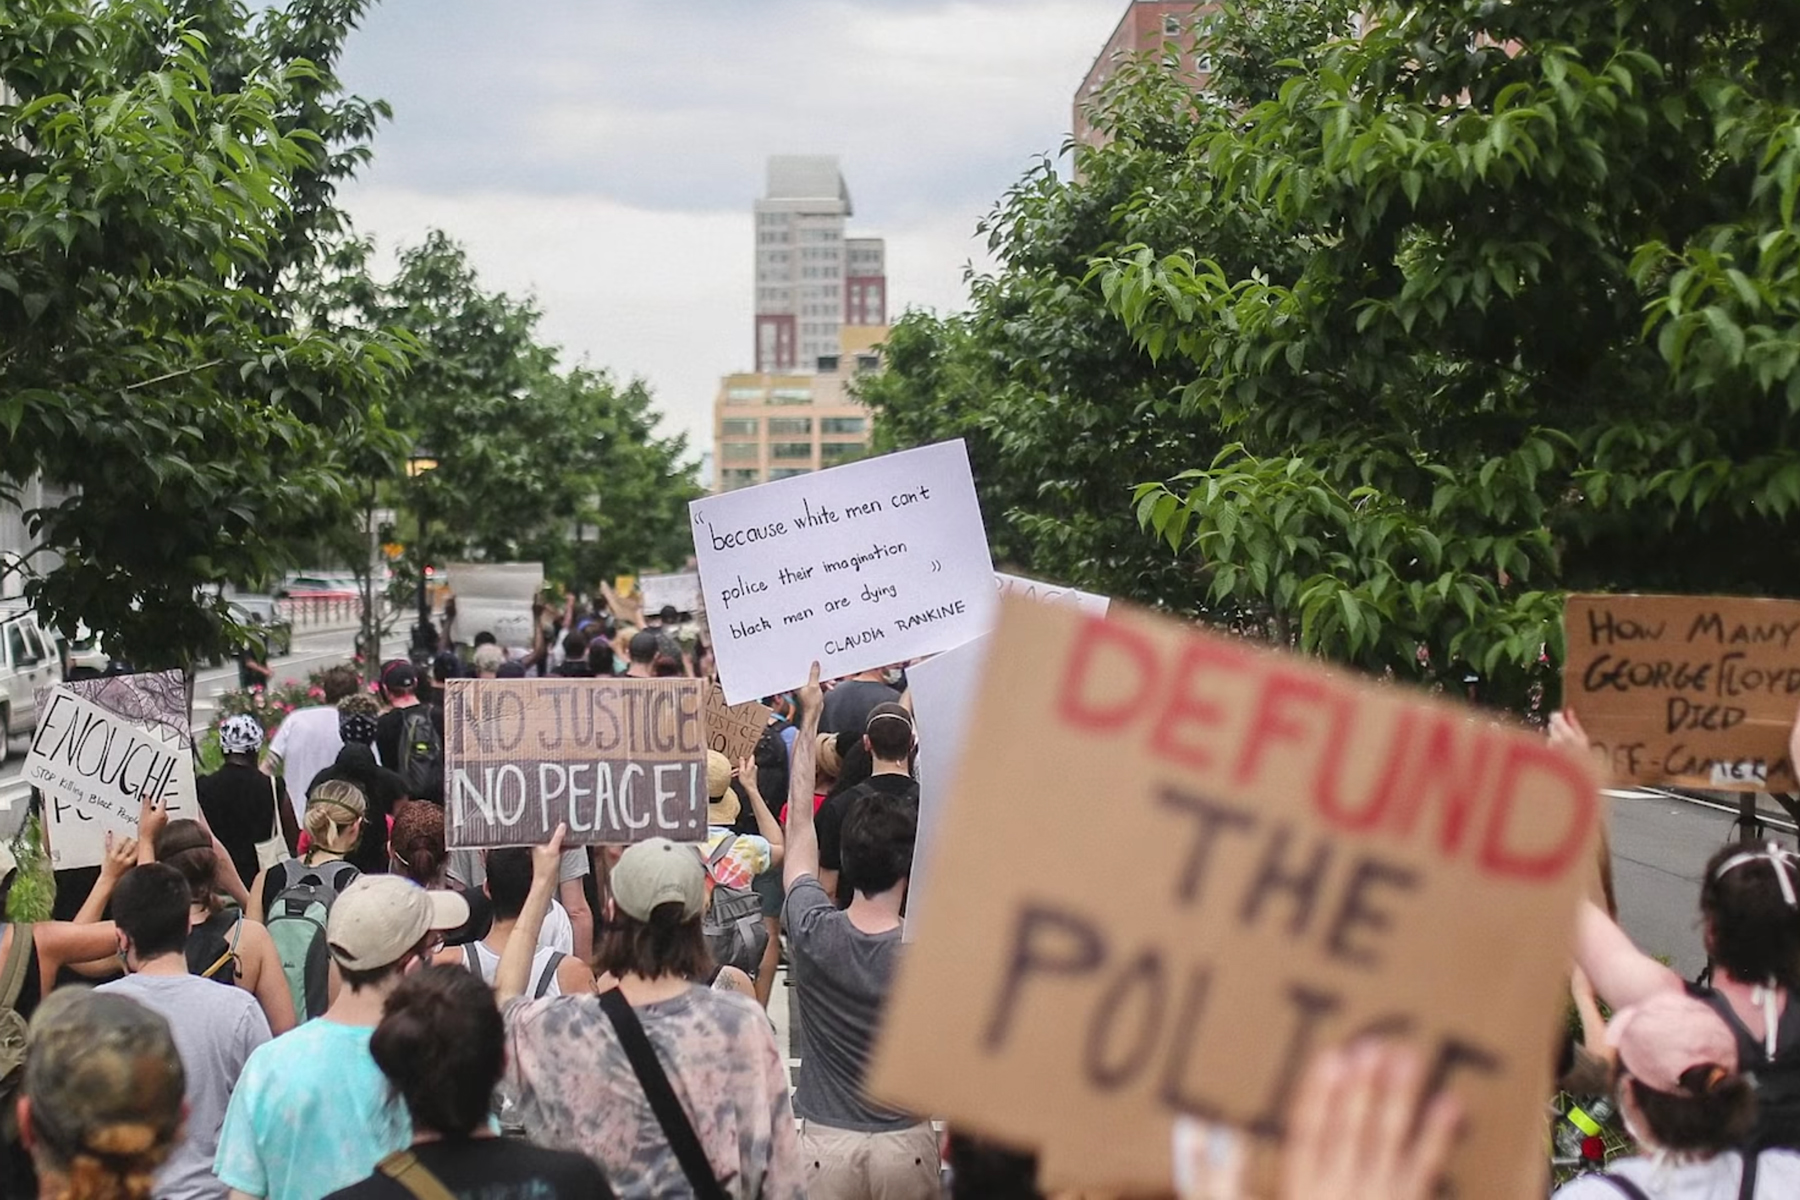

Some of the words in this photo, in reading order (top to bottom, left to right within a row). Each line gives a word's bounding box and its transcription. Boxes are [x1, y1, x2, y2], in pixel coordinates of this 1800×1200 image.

[794, 498, 840, 530] white
[845, 500, 882, 519] men
[891, 485, 931, 509] can't
[721, 575, 769, 609] police
[778, 567, 814, 586] their
[822, 543, 907, 573] imagination
[729, 617, 772, 640] black
[783, 608, 814, 626] men
[825, 597, 851, 614] are
[861, 583, 898, 604] dying
[824, 627, 886, 655] CLAUDIA
[894, 600, 967, 632] RANKINE
[1587, 609, 1667, 646] HOW
[1687, 611, 1800, 647] MANY
[1583, 653, 1711, 693] GEORGE
[452, 689, 526, 755] NO
[537, 686, 701, 754] JUSTICE
[1666, 697, 1746, 734] DIED
[31, 765, 57, 781] STOP
[1053, 612, 1600, 884] DEFUND
[452, 763, 527, 829] NO
[539, 761, 699, 833] PEACE!
[1150, 779, 1425, 970] THE
